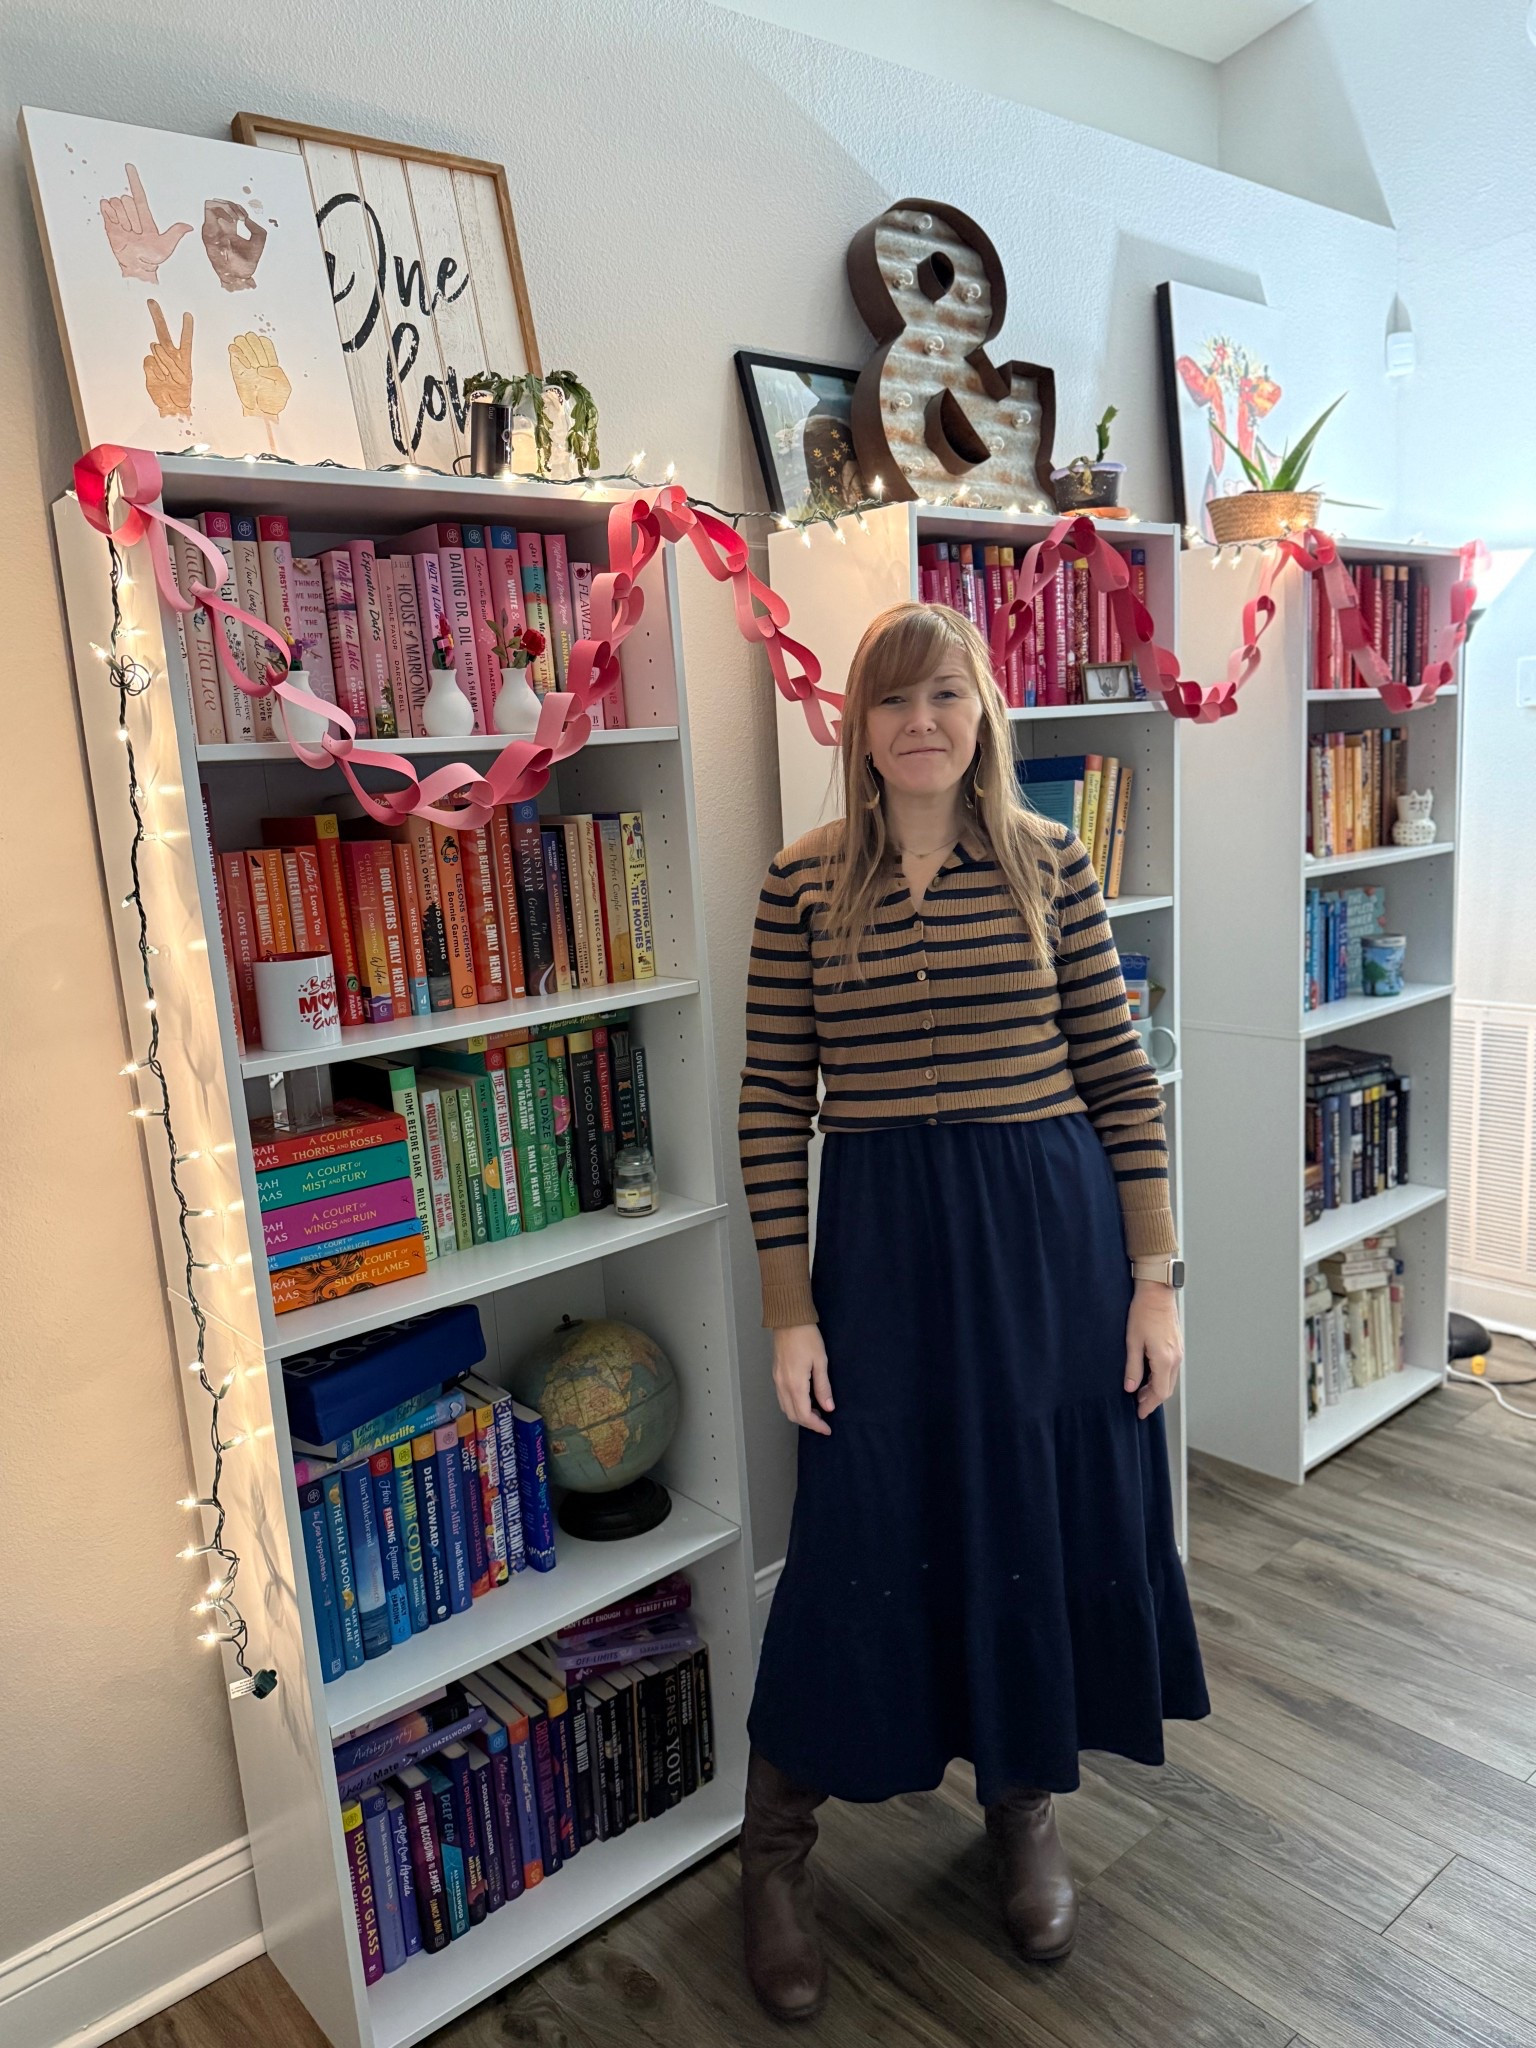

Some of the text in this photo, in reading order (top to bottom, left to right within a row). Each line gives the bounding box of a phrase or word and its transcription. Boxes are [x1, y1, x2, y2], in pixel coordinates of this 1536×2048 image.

[315, 192, 470, 352] One
[386, 322, 471, 456] Lov
[279, 566, 290, 612] FIRST-TIME
[426, 560, 438, 582] NOT
[505, 555, 518, 609] RED WHITE
[362, 552, 380, 641] Expiration Dates
[449, 553, 472, 646] DATING DR. DIL
[346, 642, 360, 671] Lake
[398, 583, 426, 710] HOUSE MARIONNE
[561, 630, 569, 668] HANNAH
[1056, 629, 1066, 656] EMILY
[1057, 660, 1066, 688] HENRY
[201, 678, 216, 711] Lee
[350, 677, 359, 713] FORTUNE
[468, 680, 478, 713] SHARMA
[231, 861, 239, 877] THE
[269, 854, 281, 901] Happiness
[358, 861, 368, 896] LAUREN
[365, 854, 376, 902] CHRISTINA
[418, 836, 432, 901] DELIA OWENS
[499, 818, 518, 933] The Correspondent
[520, 840, 533, 892] HANNAH
[533, 839, 544, 890] KRISTIN
[300, 851, 322, 936] Loathe Love You
[431, 884, 444, 935] CRAWDADS
[477, 840, 502, 984] BIG BEAUTIFUL LIFE EMILY HENRY
[640, 880, 650, 928] NOTHING
[237, 912, 247, 935] LOVE
[255, 883, 273, 945] DEAD ROMANTICS
[368, 913, 378, 953] SOMETHING
[380, 868, 406, 998] BOOK LOVERS EMILY HENRY
[448, 892, 460, 958] Bonnie Garmus
[456, 874, 473, 973] LESSONS CHEMISTRY
[528, 898, 542, 959] Great Alone
[633, 909, 643, 949] MOVIES
[241, 940, 254, 991] DECEPTION
[415, 949, 423, 973] ROME
[306, 973, 335, 995] Best
[524, 1068, 532, 1096] PEOPLE
[635, 1051, 645, 1088] LOVELIGHT
[463, 1111, 474, 1138] CHEAT
[496, 1090, 510, 1143] LOVE HATERS
[518, 1091, 529, 1130] VACATION
[292, 1134, 383, 1161] THORNS ROSES
[320, 1128, 355, 1143] COURT
[425, 1104, 443, 1180] KRISTAN HIGGINS
[483, 1116, 492, 1146] JENKINS
[317, 1162, 352, 1177] COURT
[404, 1092, 430, 1240] HOME BEFORE DARK RILEY SAGER
[467, 1142, 478, 1168] SHEET
[550, 1148, 559, 1200] CHRISTINA
[590, 1144, 600, 1186] WOODS
[302, 1170, 368, 1193] MIST FURY
[455, 1163, 465, 1198] NICHOLAS
[502, 1148, 518, 1213] KATHERINE CENTER
[528, 1145, 541, 1207] EMILY HENRY
[541, 1157, 551, 1194] LAUREN
[304, 1210, 377, 1236] WINGS RUIN
[322, 1203, 358, 1219] COURT
[475, 1203, 484, 1224] ADAMS
[300, 1240, 370, 1262] FROST STARLIGHT
[323, 1238, 347, 1249] COURT
[363, 1250, 399, 1266] COURT
[334, 1260, 410, 1287] SILVER FLAMES
[373, 1424, 416, 1450] Afterlife
[462, 1448, 470, 1471] LOVE
[498, 1411, 523, 1555] FUNNY STORY EMILY HENRY
[424, 1466, 439, 1547] DEAR EDWARD
[333, 1503, 351, 1592] THE HALF MOON
[407, 1523, 423, 1572] COLD
[447, 1468, 465, 1591] Academic Affair McAlister
[432, 1557, 441, 1600] NAPOLITANO
[345, 1618, 353, 1642] KEANE
[595, 1611, 620, 1623] ENOUGH
[665, 1675, 678, 1736] KEPNES
[432, 1724, 472, 1747] HAZELWOOD
[535, 1720, 549, 1760] CROSS
[373, 1761, 399, 1779] Mate
[666, 1737, 680, 1785] YOU
[440, 1794, 453, 1821] DEEP
[481, 1783, 490, 1819] SOULMATE
[421, 1825, 433, 1862] ACCORDING
[354, 1830, 380, 1956] HOUSE OF GLASS
[467, 1855, 476, 1891] MIRANDA
[454, 1879, 464, 1919] HAZELWOOD
